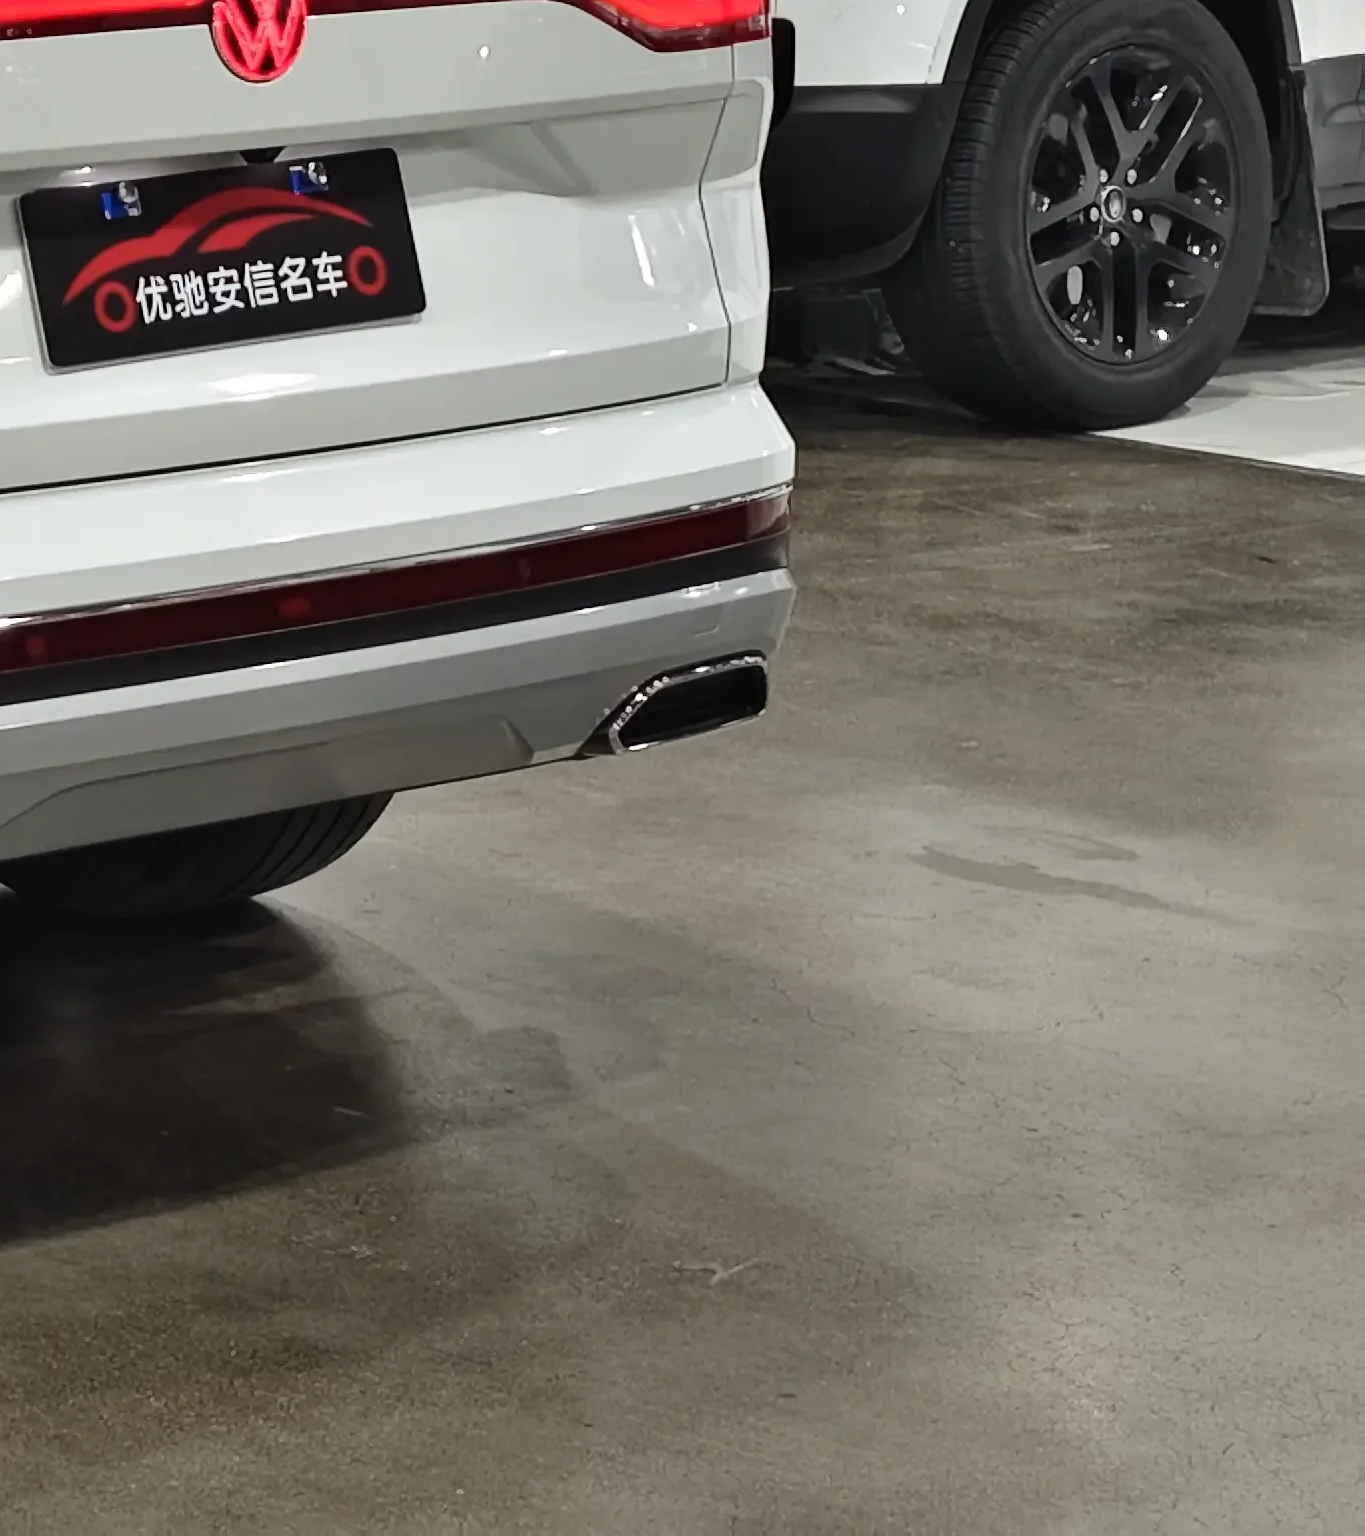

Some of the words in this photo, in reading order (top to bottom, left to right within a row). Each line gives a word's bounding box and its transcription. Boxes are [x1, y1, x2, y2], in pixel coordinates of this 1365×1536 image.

[135, 250, 349, 324] 优驰安信名车
